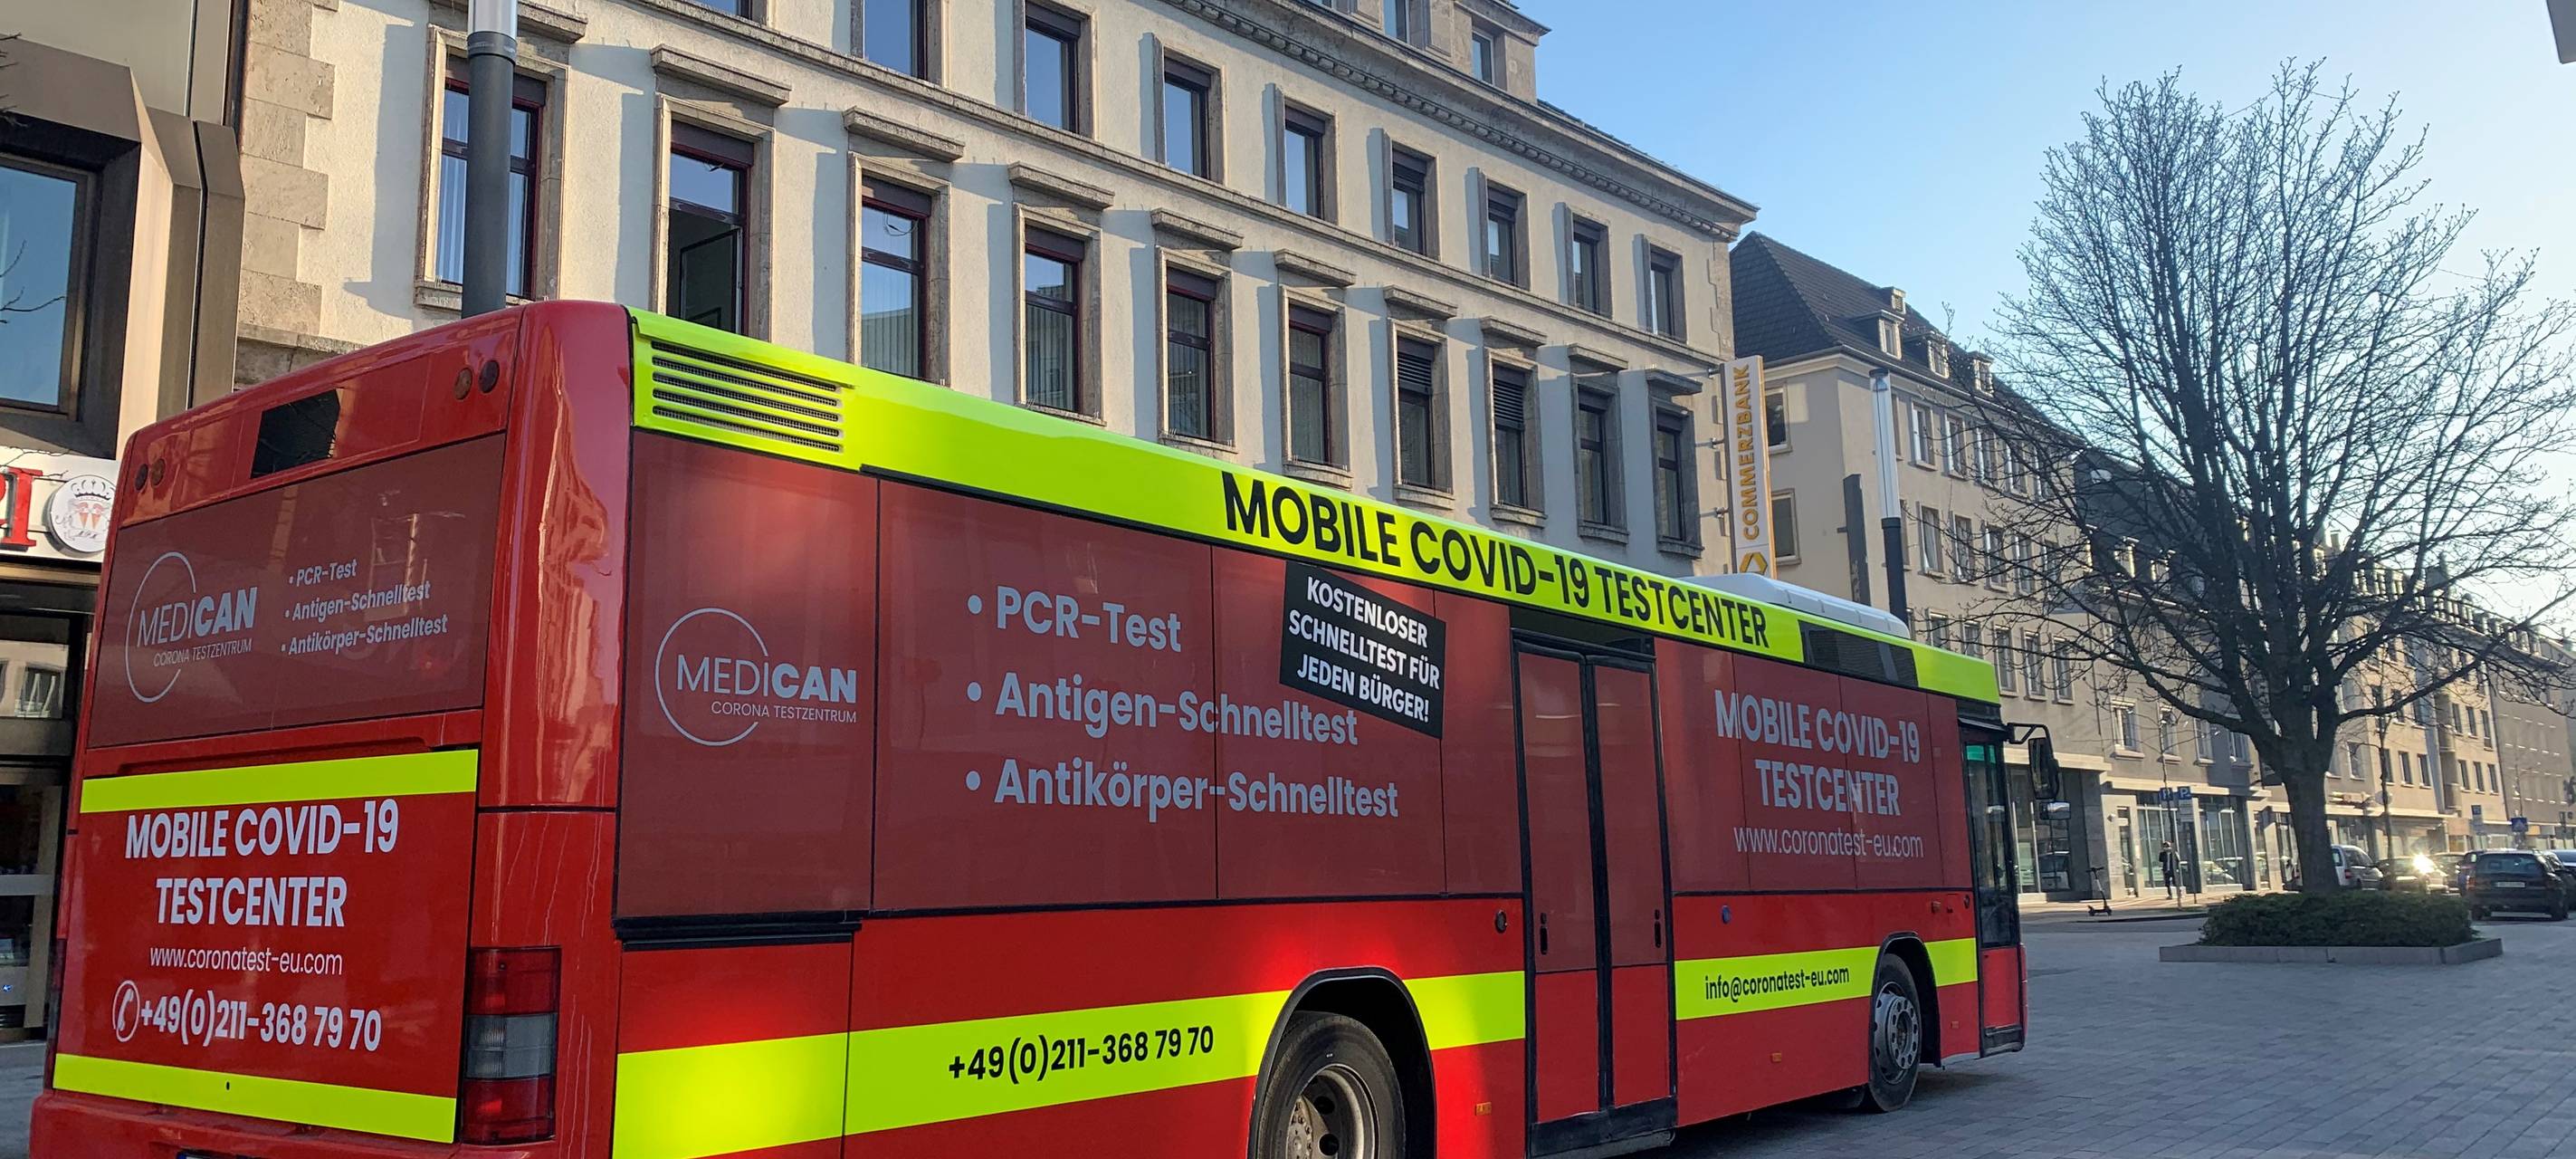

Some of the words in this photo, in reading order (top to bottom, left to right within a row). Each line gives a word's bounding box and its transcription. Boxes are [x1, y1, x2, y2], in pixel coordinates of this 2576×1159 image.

[1733, 364, 1760, 541] COMMERZBANK
[296, 560, 358, 587] PCR-Test
[1222, 472, 1401, 568] MOBILE
[1410, 522, 1589, 608] COVID-19
[1594, 567, 1770, 649] TESTCENTER
[137, 587, 258, 647] MEDICAN
[291, 580, 431, 623] Antigen-Schnelltest
[997, 586, 1181, 653] PCR-Test
[1307, 576, 1428, 648] KOSTENLOSER
[153, 646, 190, 667] CORONA
[192, 638, 253, 662] TESTZENTRUM
[288, 614, 448, 656] Antikörper-Schnelltest
[1288, 609, 1407, 676] SCHNELLTEST
[1409, 652, 1440, 690] FÜR
[677, 654, 857, 704] MEDICAN
[1297, 654, 1355, 697] JEDEN
[1359, 671, 1429, 723] BÜRGER!
[711, 700, 769, 718] CORONA
[774, 704, 857, 723] TESTZENTRUM
[996, 672, 1358, 745] Antigen-Schnelltest
[1714, 689, 1812, 749] MOBILE
[1816, 708, 1920, 763] COVID-19
[994, 758, 1398, 823] Antikörper-Schnelltest
[1755, 759, 1902, 816] TESTCENTER
[126, 809, 228, 859] MOBILE
[234, 798, 399, 856] COVID-19
[1733, 826, 1924, 858] www.coronatest-eu.com
[157, 876, 348, 927] TESTCENTER
[150, 945, 343, 975] www.coronatest-eu.com
[1705, 965, 1850, 1004] info@coronatest-eu.com
[313, 1007, 341, 1049] 79
[350, 1010, 382, 1052] 70
[1155, 1027, 1182, 1059] 79
[1188, 1025, 1214, 1056] 70
